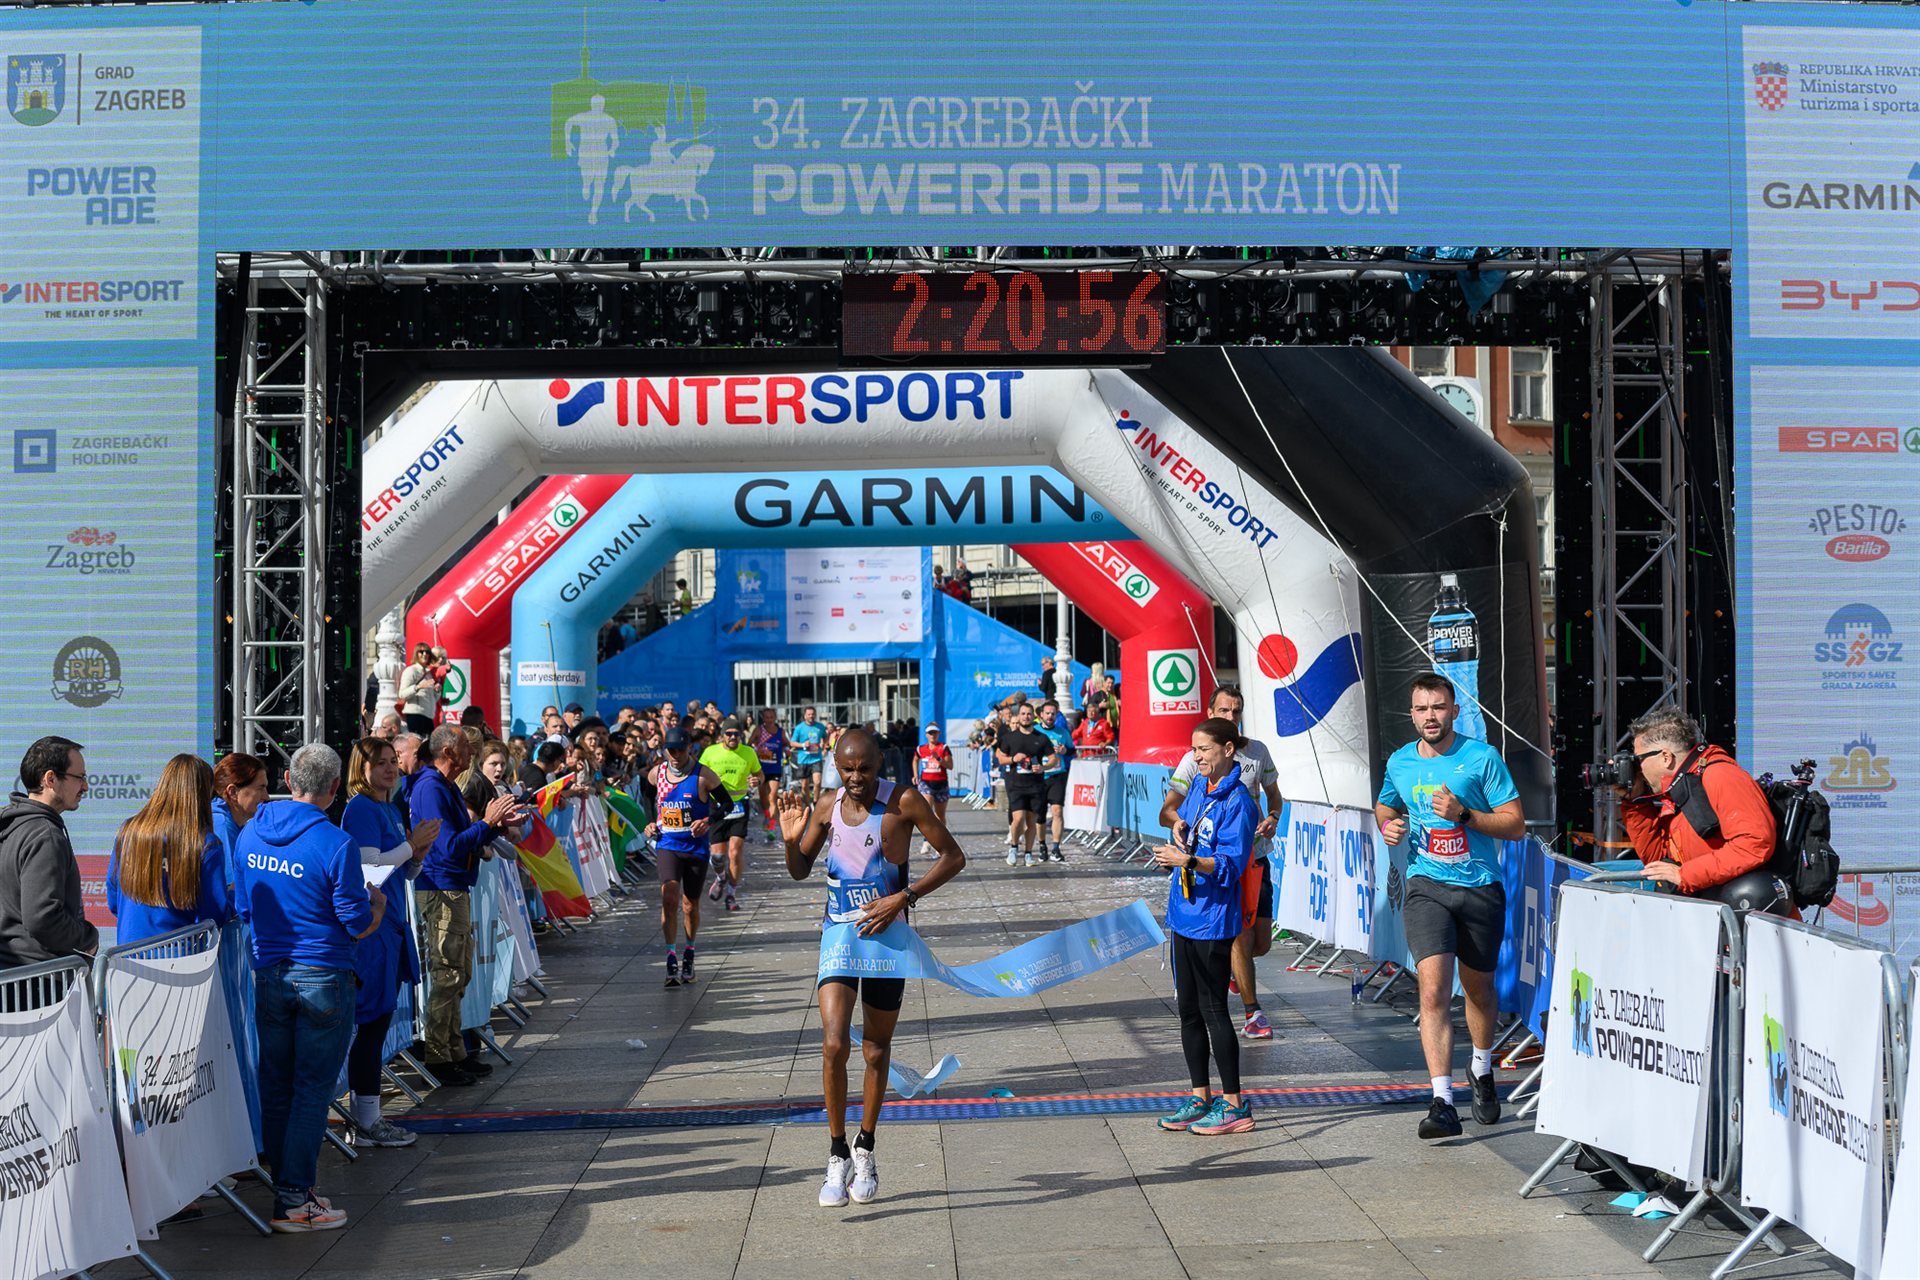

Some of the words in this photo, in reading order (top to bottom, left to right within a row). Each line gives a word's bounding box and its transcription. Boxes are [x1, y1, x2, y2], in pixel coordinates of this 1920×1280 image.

[95, 66, 135, 80] GRAD
[1800, 64, 1873, 75] REPUBLIKA
[1800, 78, 1898, 94] Ministarstvo
[94, 88, 187, 111] ZAGREB
[1800, 97, 1860, 111] turizma
[1863, 98, 1870, 111] i
[1872, 99, 1920, 115] sporta
[752, 96, 821, 150] 34.
[840, 80, 1153, 149] ZAGREBAČKI
[27, 165, 157, 196] POWER
[752, 162, 1144, 216] POWERADE
[1156, 162, 1402, 215] MARATON
[24, 280, 184, 304] INTERSPORT
[1781, 279, 1920, 312] BYD
[44, 310, 62, 319] THE
[65, 309, 96, 319] HEART
[98, 309, 111, 318] OF
[113, 308, 143, 318] SPORT
[893, 271, 1162, 351] 2:20:56
[616, 370, 1025, 427] INTERSPORT
[72, 435, 169, 450] ZAGREBAČKI
[1807, 431, 1897, 448] SPAR
[72, 451, 138, 466] HOLDING
[1134, 427, 1279, 549] INTERSPORT
[1141, 463, 1157, 480] THE
[1158, 479, 1186, 503] HEART
[1186, 502, 1198, 513] OF
[1198, 512, 1226, 536] SPORT
[366, 536, 383, 552] THE
[384, 511, 411, 537] HEART
[409, 499, 421, 512] OF
[421, 475, 448, 501] SPORT
[733, 475, 1087, 529] GARMIN
[1816, 503, 1899, 536] PESTO
[45, 543, 136, 575] Zagreb
[483, 522, 557, 594] SPAR
[560, 513, 652, 604] GARMIN
[1833, 541, 1885, 555] Barilla
[1085, 544, 1127, 578] AR
[69, 658, 106, 680] RH
[520, 673, 537, 682] beat
[1868, 671, 1896, 680] SAVEZ
[1153, 701, 1199, 712] SPAR
[87, 774, 137, 786] OATIA
[663, 816, 680, 827] 303
[1432, 836, 1465, 854] 2302
[247, 853, 304, 879] SUDAC
[846, 887, 880, 908] 1504
[850, 959, 897, 972] MARATON
[141, 1055, 158, 1088] 34.
